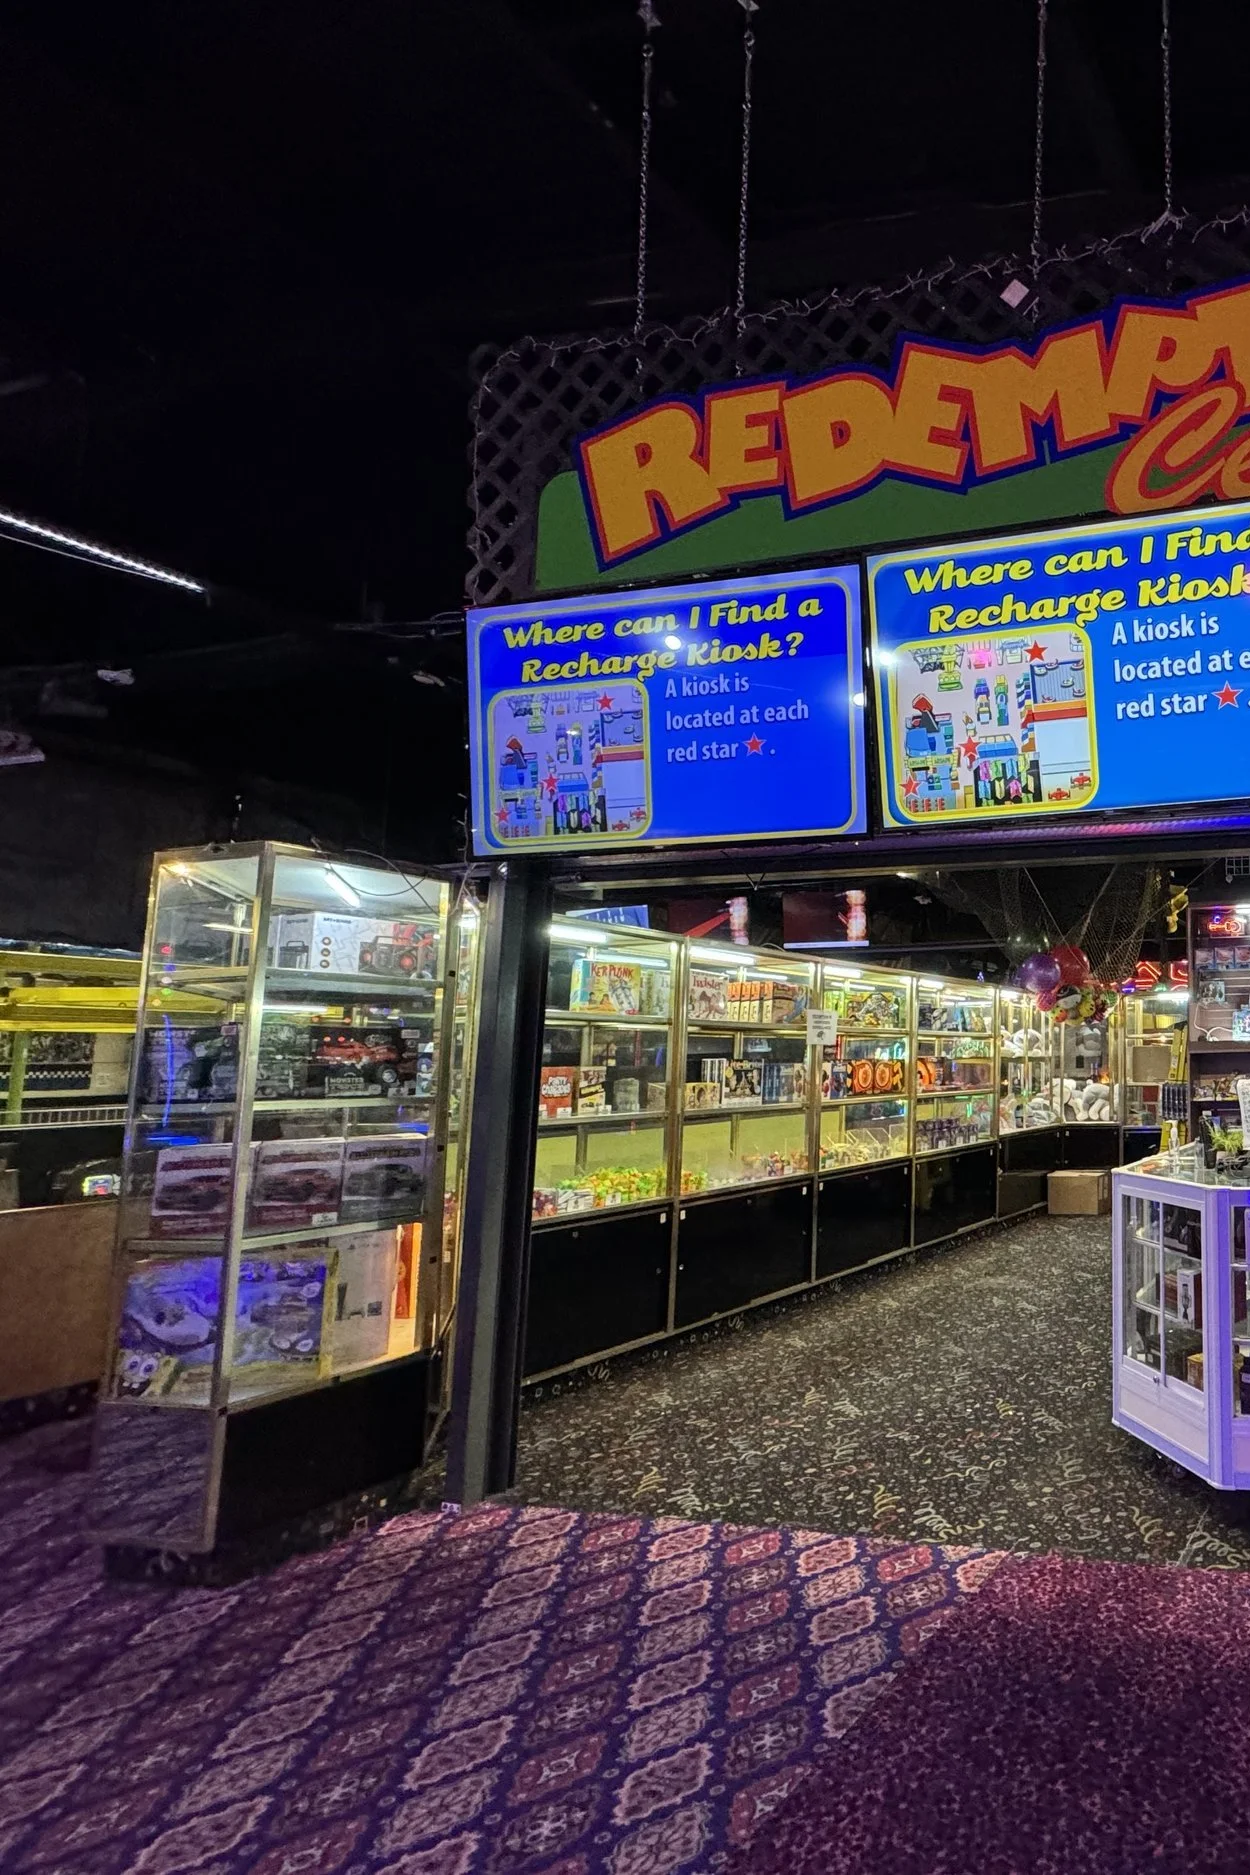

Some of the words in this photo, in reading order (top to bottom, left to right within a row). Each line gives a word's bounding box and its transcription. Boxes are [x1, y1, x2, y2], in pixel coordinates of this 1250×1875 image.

[904, 560, 1034, 595] Where
[1044, 547, 1128, 577] can
[1140, 535, 1154, 565] I
[503, 621, 605, 649] Where
[614, 612, 679, 639] can
[689, 606, 700, 629] I
[709, 593, 790, 627] Find
[798, 597, 823, 617] a
[929, 587, 1126, 633] Recharge
[1112, 622, 1127, 645] A
[1133, 613, 1195, 642] kiosk
[1200, 611, 1220, 635] is
[521, 649, 677, 682] Recharge
[686, 632, 804, 666] Kiosk?
[1114, 650, 1202, 682] located
[1207, 654, 1233, 672] at
[666, 678, 677, 698] A
[682, 674, 730, 696] kiosk
[735, 674, 749, 691] is
[666, 705, 735, 730] located
[740, 707, 760, 724] at
[764, 699, 809, 722] each
[1116, 693, 1155, 720] red
[1160, 693, 1208, 715] star
[667, 742, 697, 762] red
[702, 742, 739, 759] star
